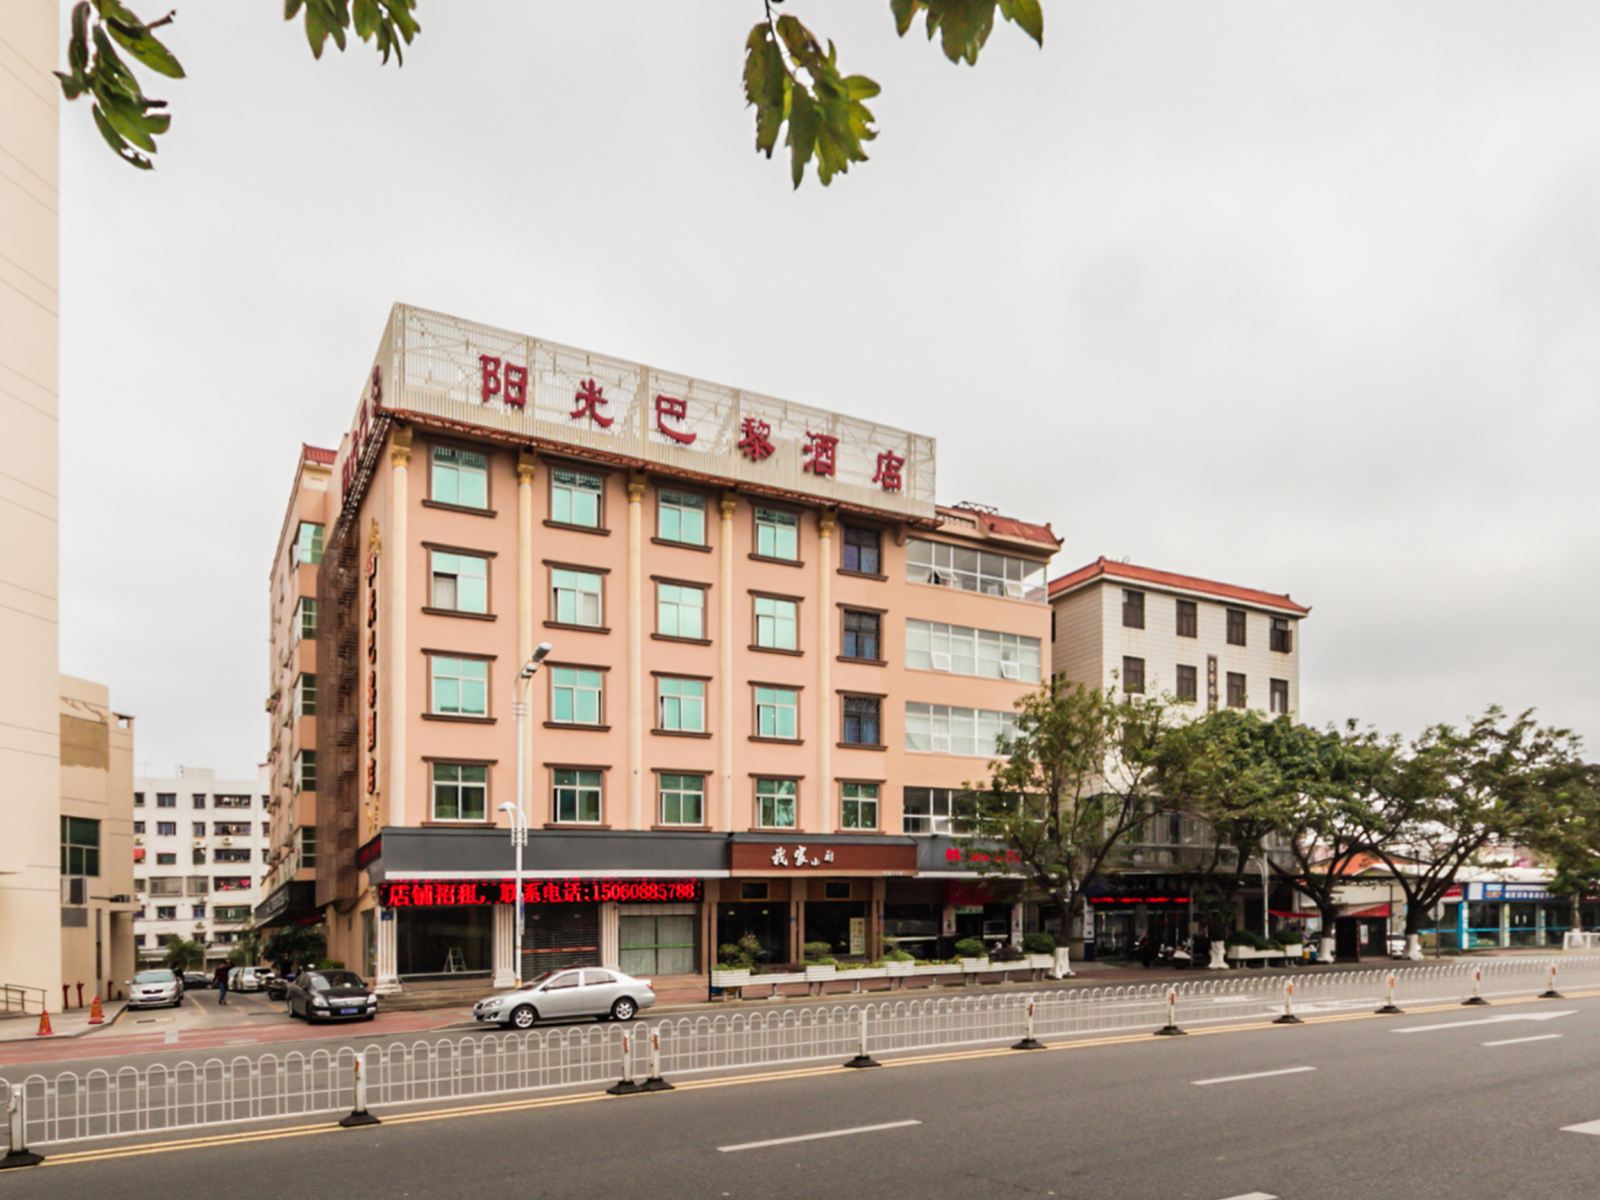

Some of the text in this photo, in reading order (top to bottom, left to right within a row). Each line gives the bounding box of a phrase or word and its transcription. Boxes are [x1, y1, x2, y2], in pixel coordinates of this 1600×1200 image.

[479, 354, 905, 490] 阳光巴黎酒店
